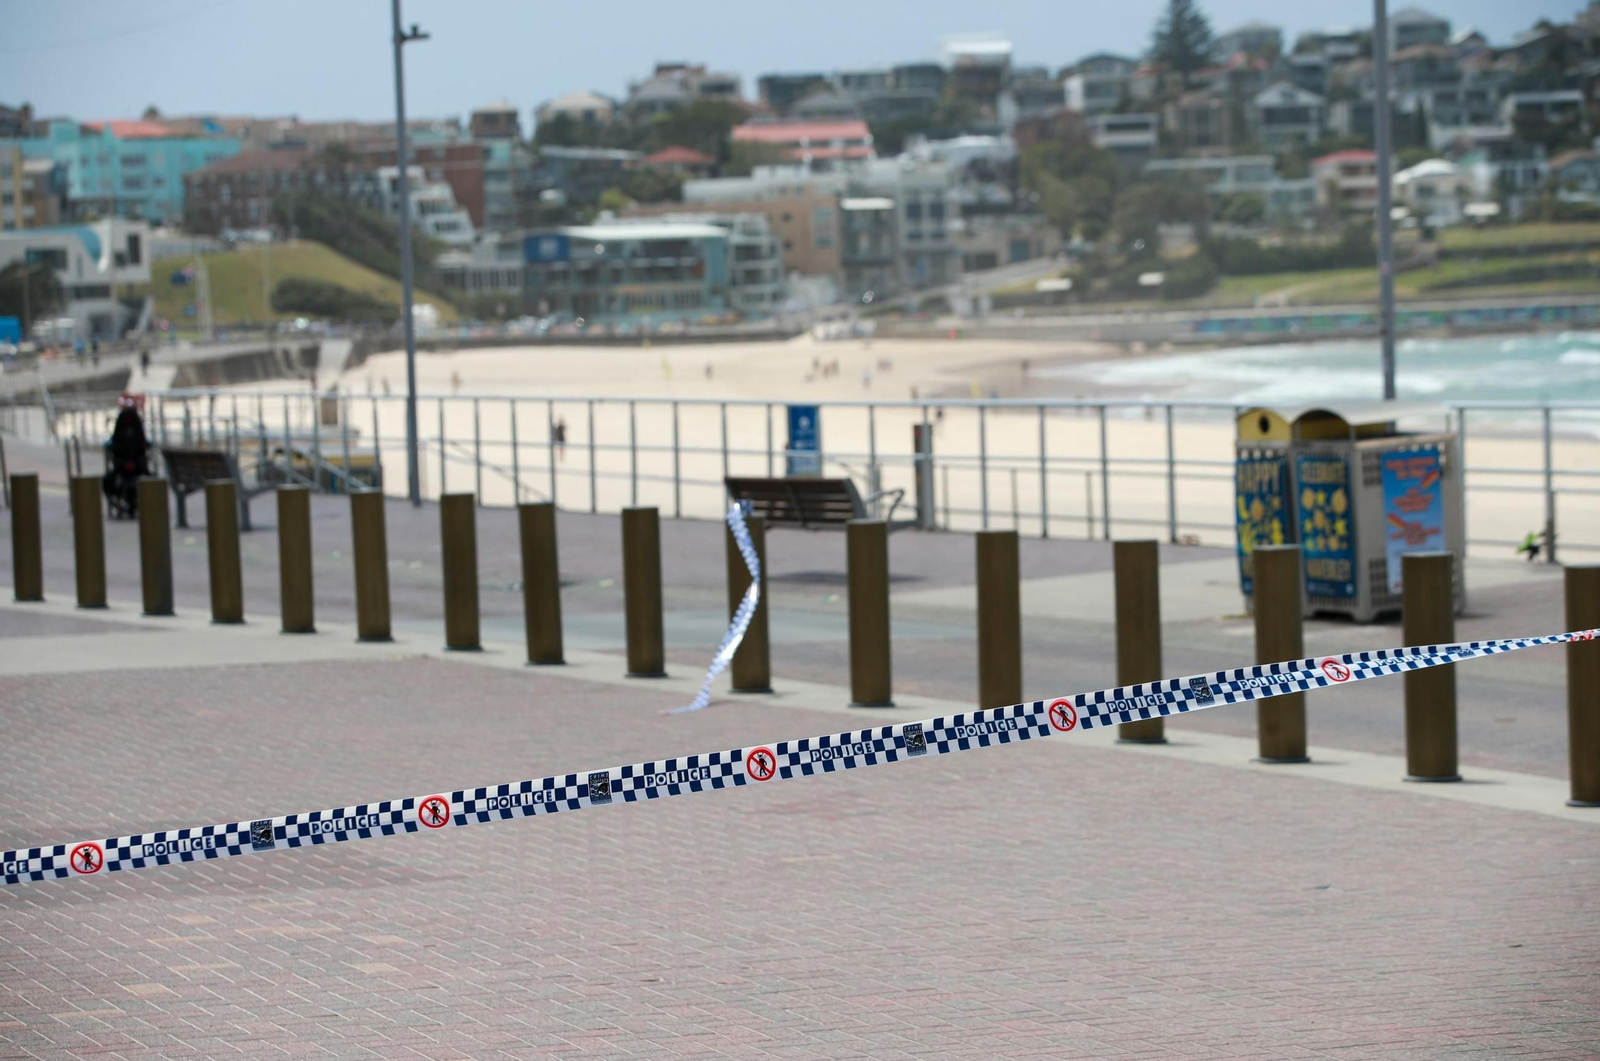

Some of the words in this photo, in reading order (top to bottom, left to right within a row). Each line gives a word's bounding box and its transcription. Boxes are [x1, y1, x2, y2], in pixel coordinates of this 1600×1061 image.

[1238, 461, 1280, 493] HAPPY
[1378, 653, 1429, 667] POLICE
[1240, 673, 1295, 689] POLICE
[1108, 694, 1164, 712] POLICE
[904, 724, 922, 732] CRIME
[957, 719, 1016, 738] POLICE
[812, 742, 873, 762] POLICE
[590, 772, 609, 780] CRIME
[646, 768, 709, 787] POLICE
[489, 789, 552, 810] POLICE
[311, 815, 378, 834] POLICE
[144, 837, 212, 857] POLICE
